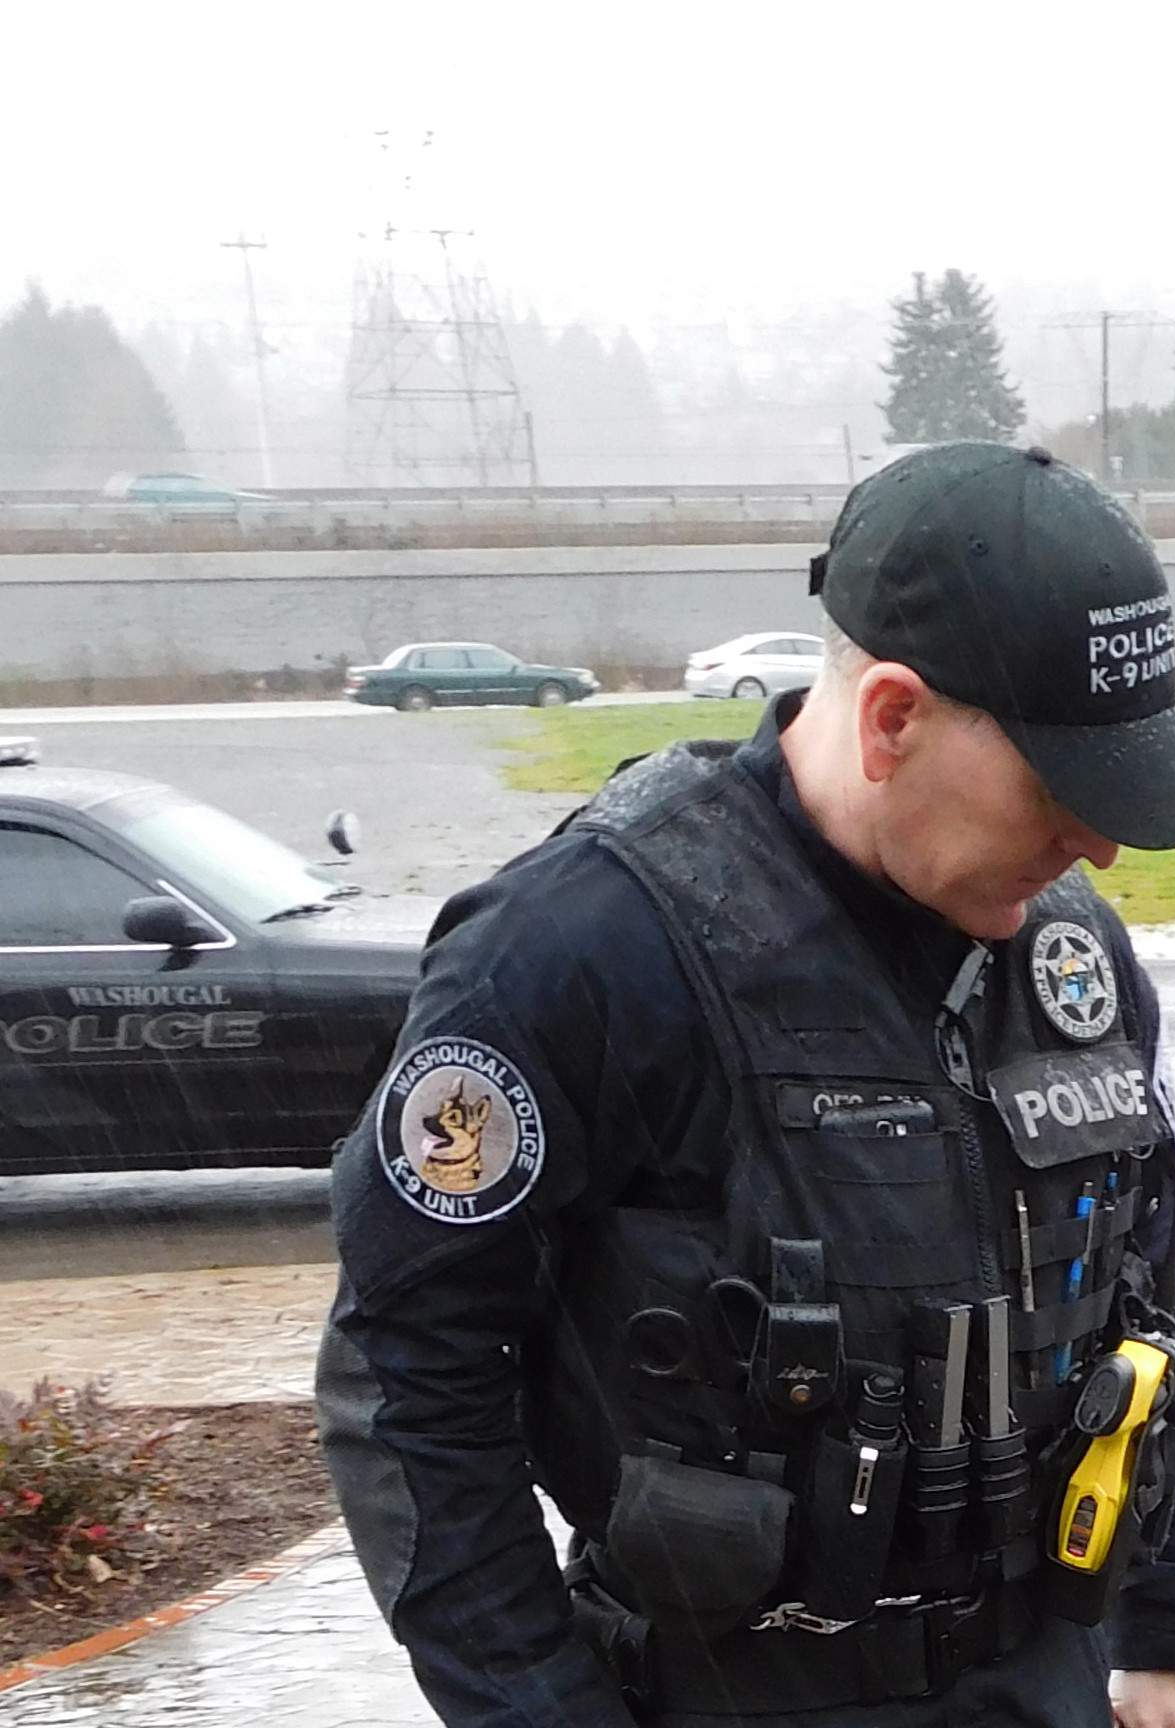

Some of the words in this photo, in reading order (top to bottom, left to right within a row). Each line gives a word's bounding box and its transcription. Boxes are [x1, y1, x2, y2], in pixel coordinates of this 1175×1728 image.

[1089, 618, 1175, 663] POLICE
[1090, 661, 1139, 694] K-9
[1142, 648, 1175, 682] UNIT
[67, 985, 232, 1007] WASHOUGAL
[0, 1010, 267, 1054] OLICE
[393, 1044, 507, 1096] WASHOUGAL
[506, 1083, 538, 1171] POLICE
[1014, 1069, 1148, 1138] POLICE
[390, 1154, 422, 1194] K-9
[423, 1193, 477, 1217] UNIT
